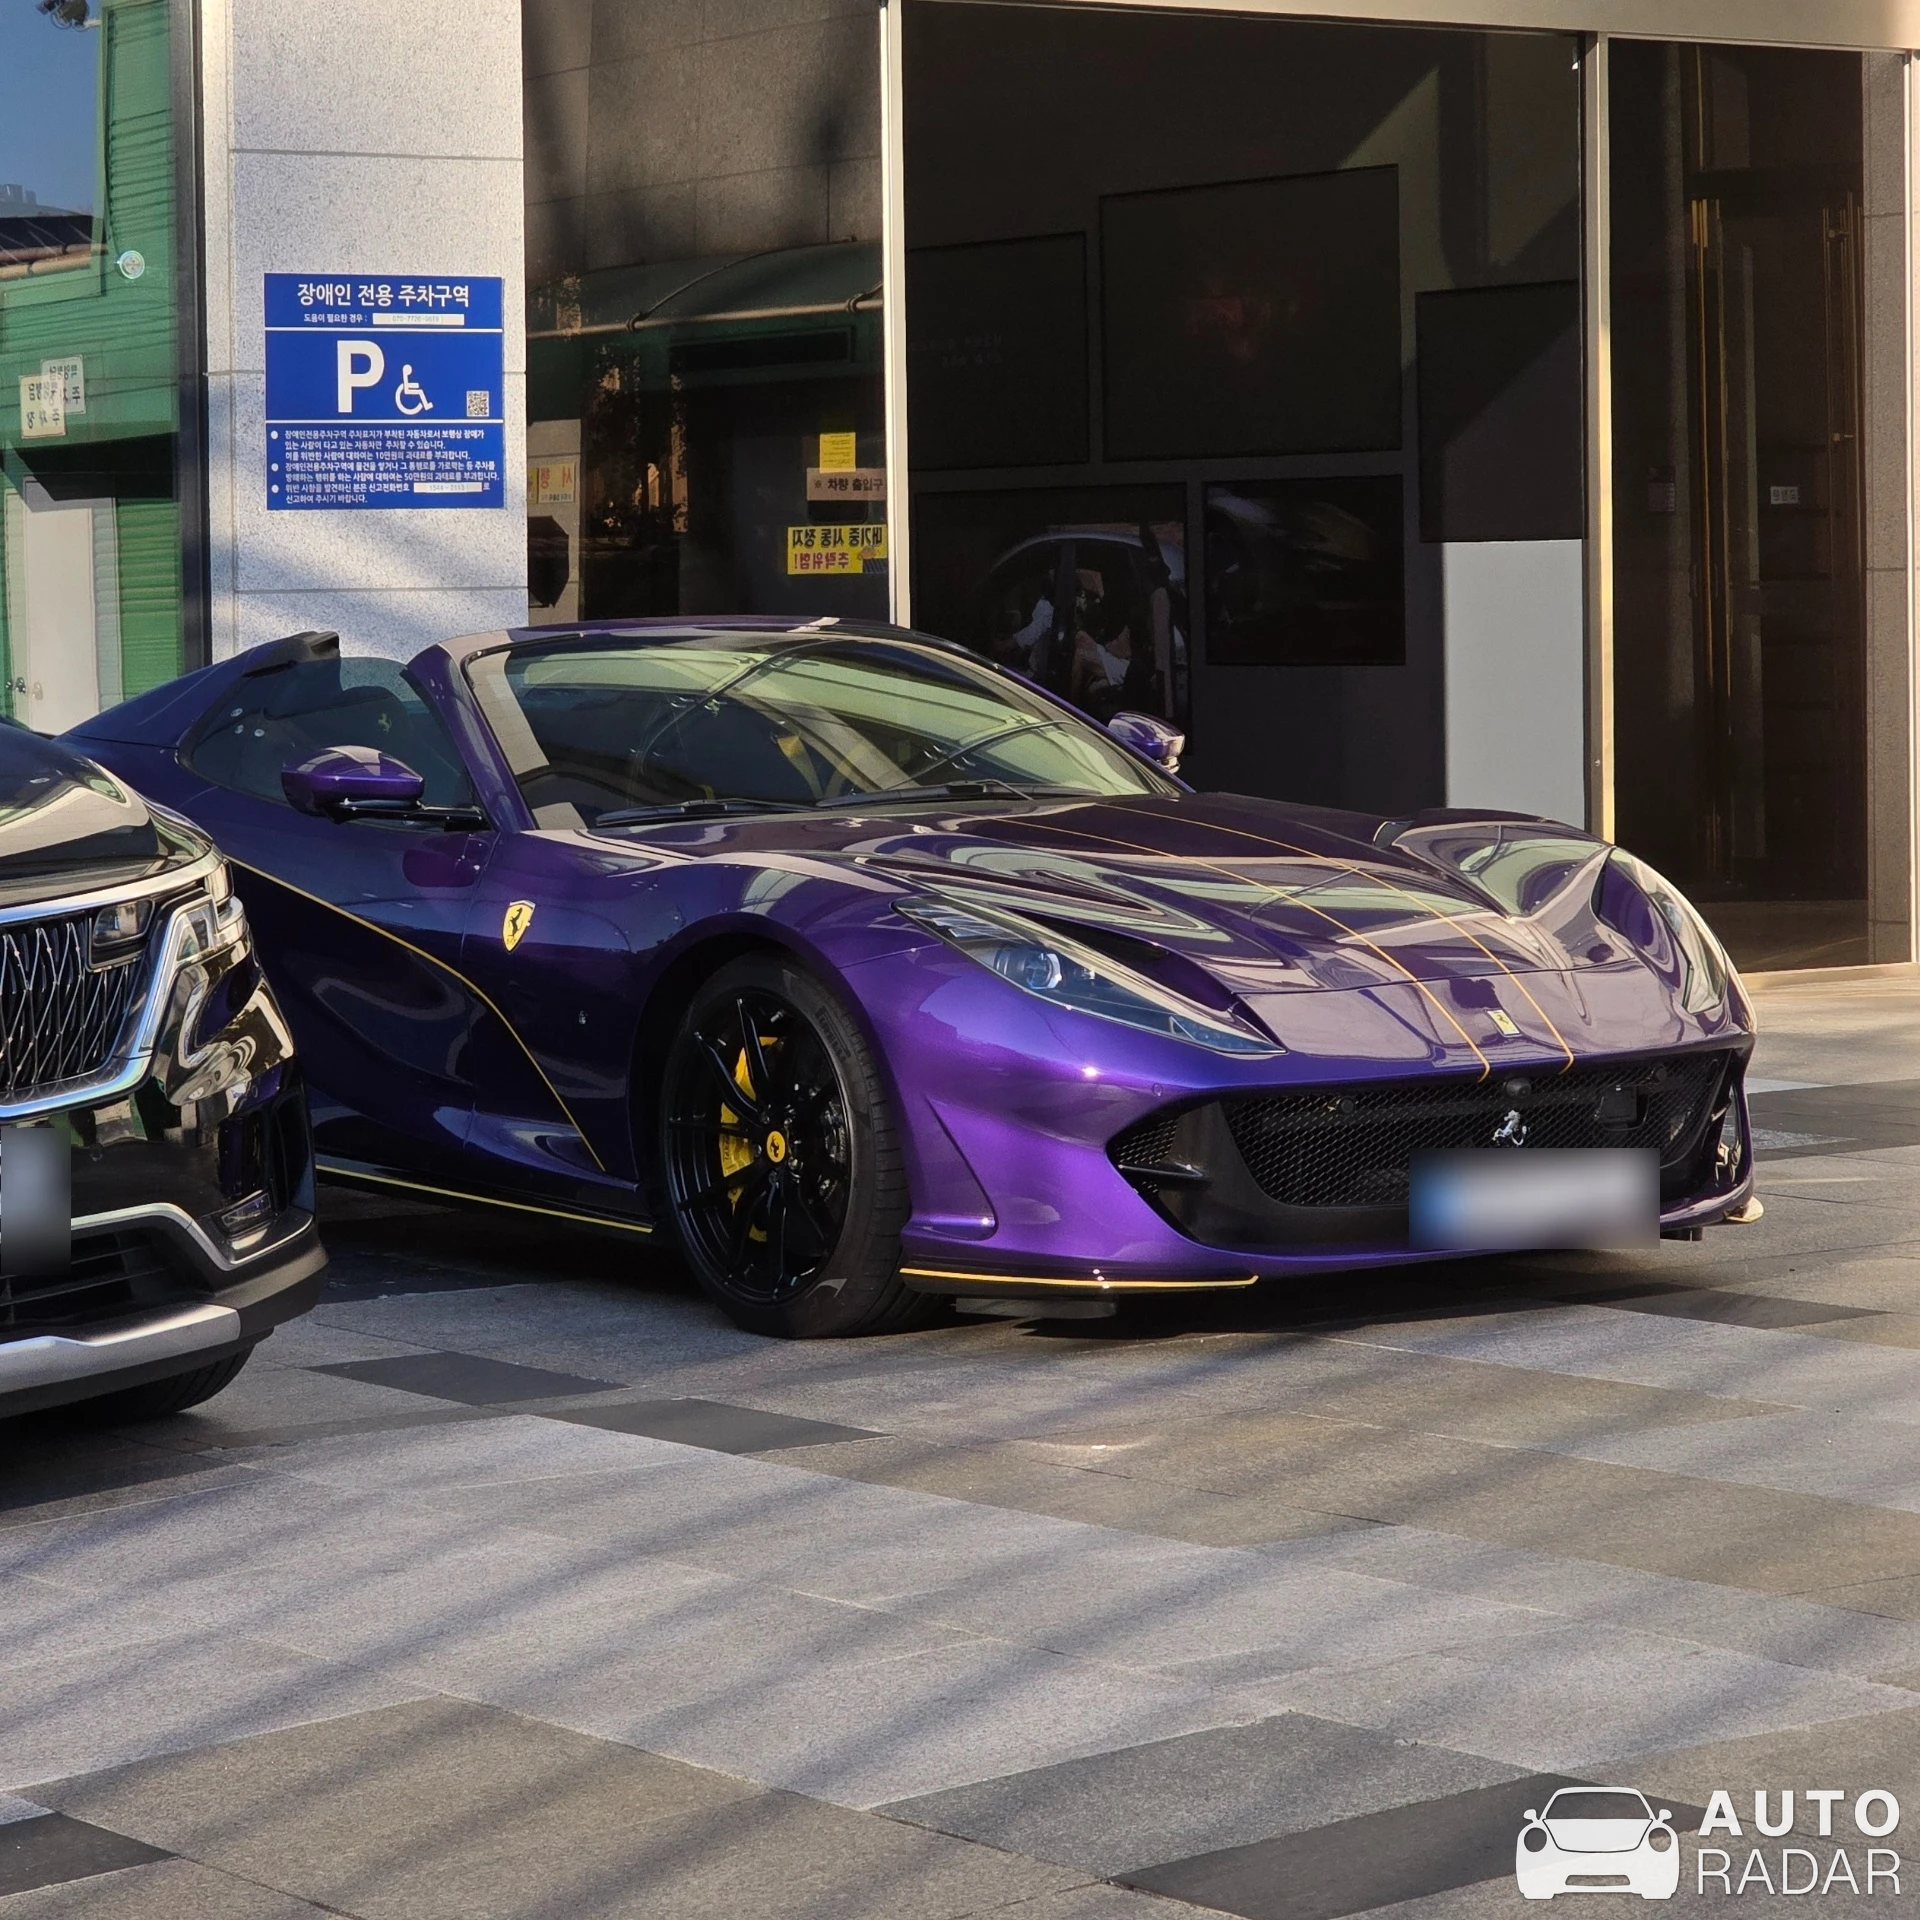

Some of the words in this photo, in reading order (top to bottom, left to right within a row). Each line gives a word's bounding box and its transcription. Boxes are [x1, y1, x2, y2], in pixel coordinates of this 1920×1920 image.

[297, 283, 351, 306] 장애인
[357, 284, 394, 307] 전용
[398, 285, 470, 308] 주차구역
[304, 313, 325, 323] 도움이
[326, 313, 348, 324] 필요한
[349, 313, 364, 324] 경우
[336, 340, 385, 413] P
[284, 430, 347, 439] 장애인전용주차구역
[406, 429, 441, 439] 자동차로서
[441, 429, 463, 439] 보행상
[463, 429, 485, 439] 장애가
[284, 440, 300, 450] 있는
[300, 440, 322, 450] 사람이
[323, 440, 338, 450] 타고
[338, 440, 354, 450] 있는
[354, 440, 383, 450] 자동차만
[385, 440, 407, 450] 주차할
[407, 440, 415, 449] 수
[416, 440, 446, 449] 있습니다.
[323, 451, 345, 461] 사람에
[345, 451, 374, 461] 대하여는
[434, 451, 471, 460] 부과합니다.
[285, 462, 355, 471] 장애인전용주차구역에
[355, 462, 377, 471] 물건을
[399, 461, 408, 471] 그
[474, 461, 496, 470] 주차를
[337, 473, 352, 482] 하는
[352, 473, 374, 482] 사람에
[374, 472, 403, 482] 대하여는
[463, 472, 500, 481] 부과합니다.
[827, 478, 849, 491] 차량
[852, 478, 884, 492] 출입구
[315, 494, 337, 504] 주시기
[337, 494, 368, 504] 바랍니다.
